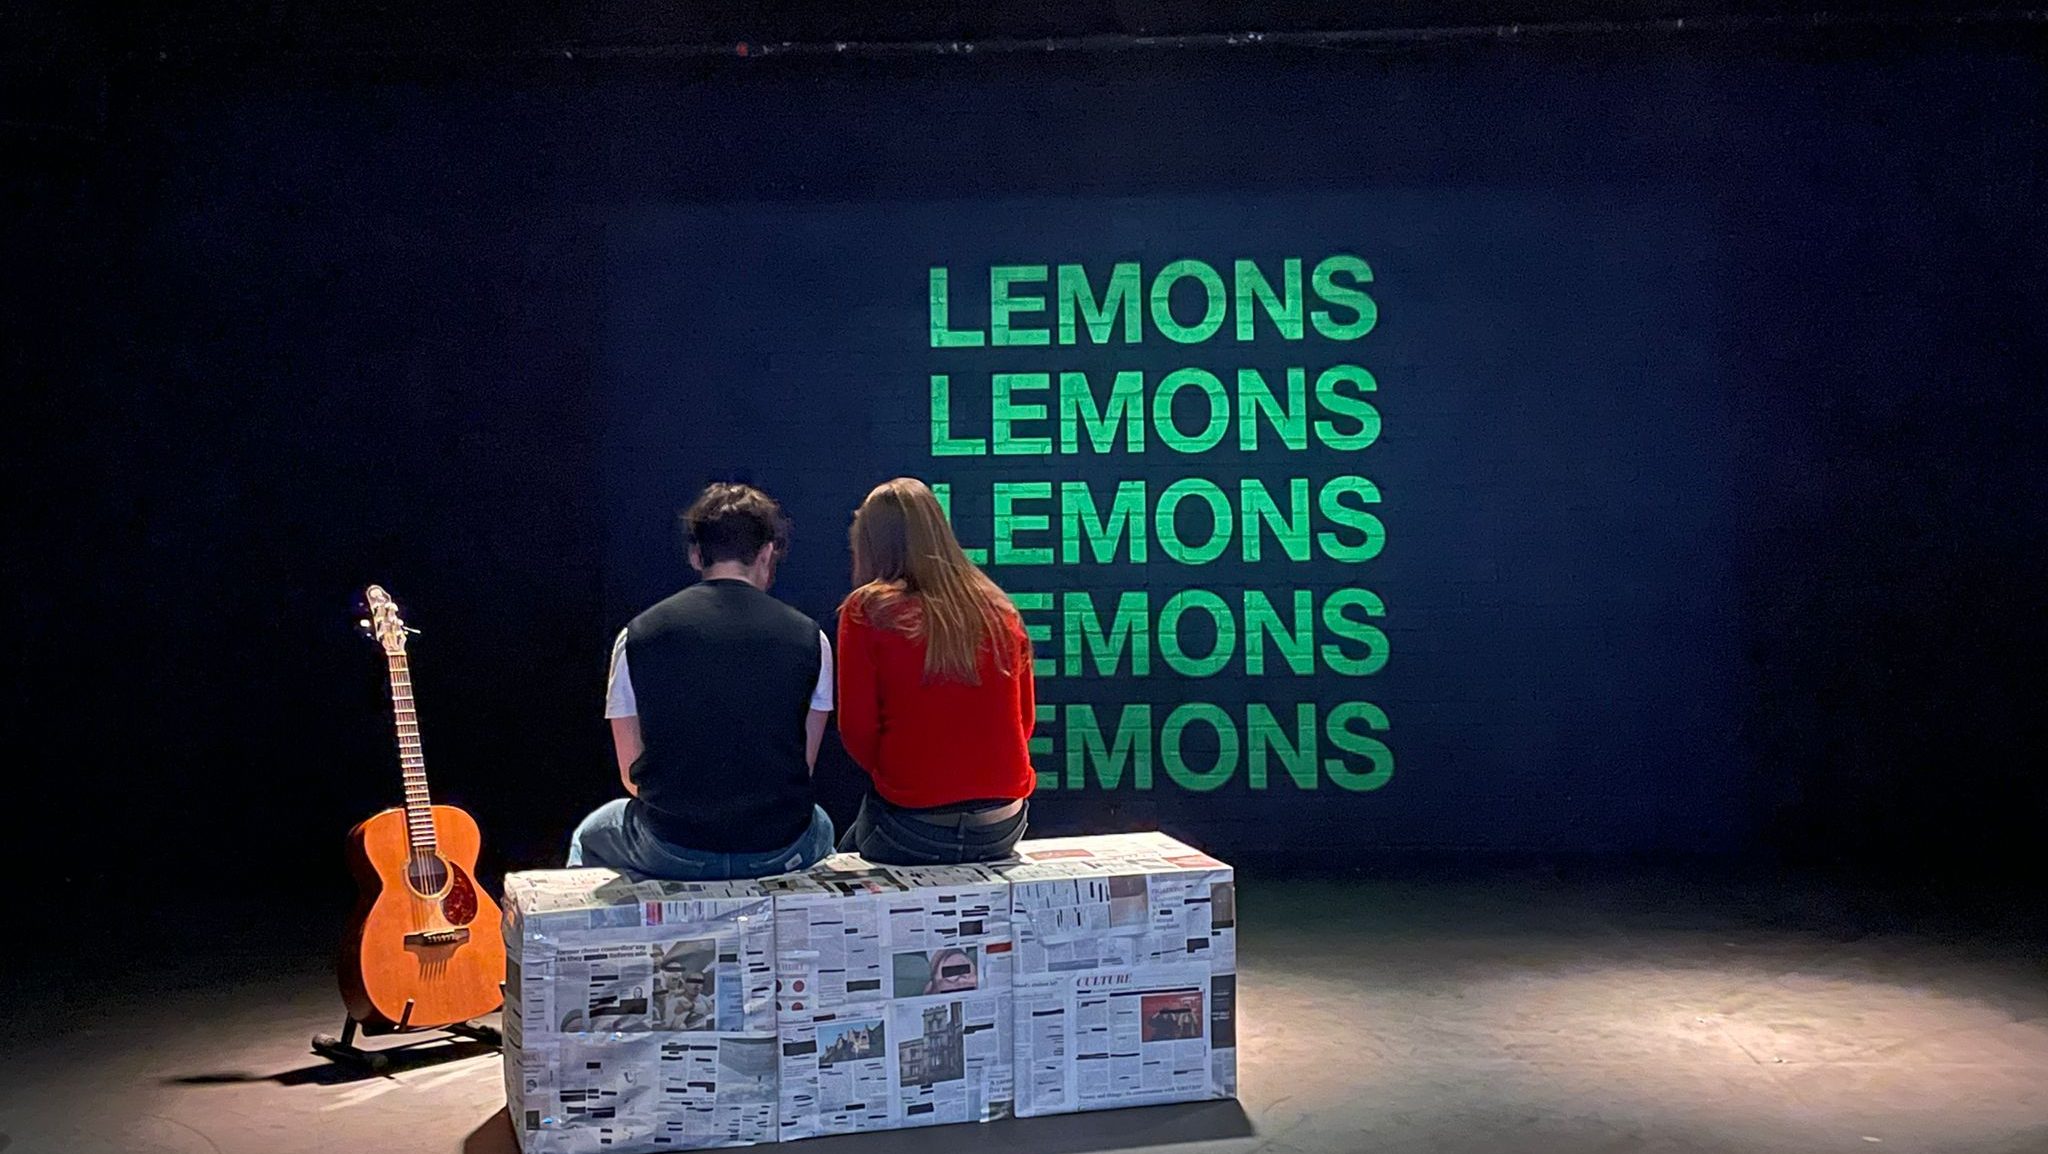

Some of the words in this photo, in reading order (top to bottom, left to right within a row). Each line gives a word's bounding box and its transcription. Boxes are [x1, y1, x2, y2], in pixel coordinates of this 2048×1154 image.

[931, 256, 1377, 348] LEMONS
[931, 365, 1380, 456] LEMONS
[1031, 702, 1393, 790] MONS
[1076, 973, 1132, 987] CULTURE
